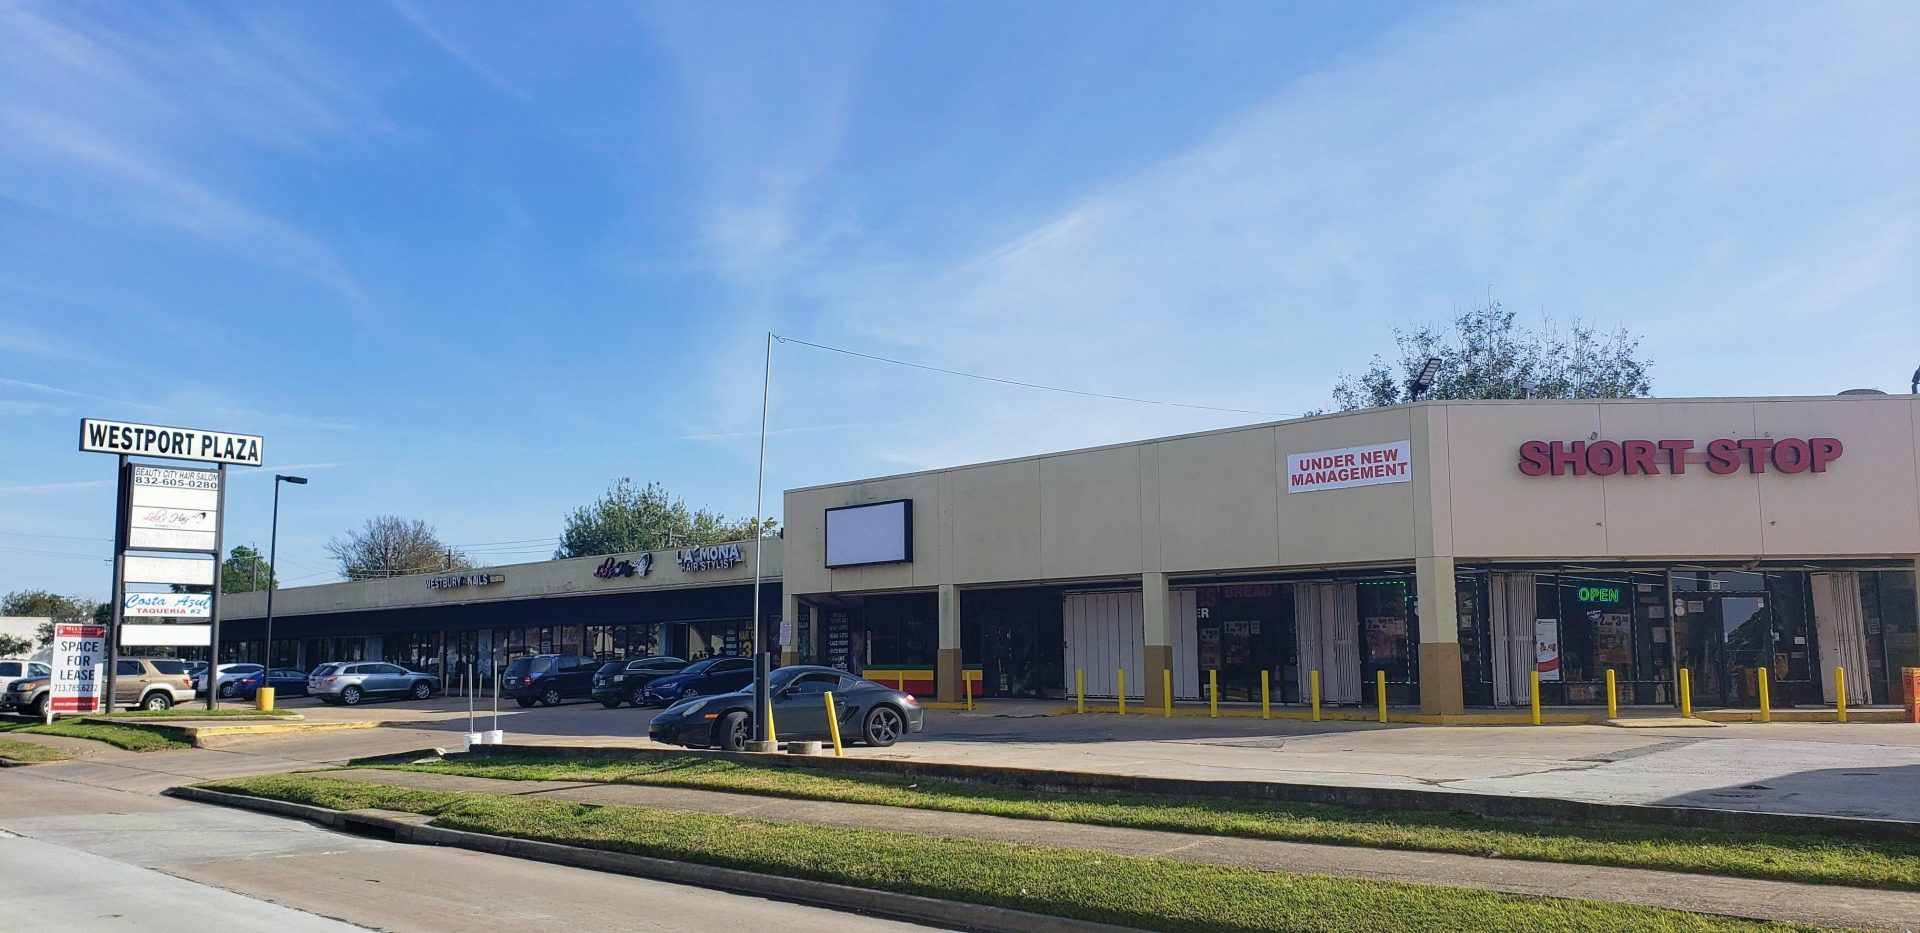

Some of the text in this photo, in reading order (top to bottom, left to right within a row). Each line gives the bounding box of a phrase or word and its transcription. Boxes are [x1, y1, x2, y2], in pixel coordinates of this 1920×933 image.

[89, 423, 259, 461] WESTPORT PLAZA
[1299, 448, 1399, 472] UNDER NEW
[1518, 438, 1843, 476] SHORT STOP
[135, 467, 217, 482] BEAUTY CITY HAIR SALON
[1291, 461, 1408, 487] MANAGEMENT
[135, 476, 217, 490] 832-605-0280
[675, 543, 740, 564] LA MONA
[681, 558, 734, 572] HAIR STYLIST
[425, 574, 488, 589] WESTBURY NAILS
[124, 594, 212, 610] Costa Azul
[1578, 587, 1619, 603] OPEN
[136, 607, 187, 615] TAQUERIA
[61, 641, 99, 652] SPACE
[66, 655, 91, 666] FOR
[60, 669, 95, 681] LEASE
